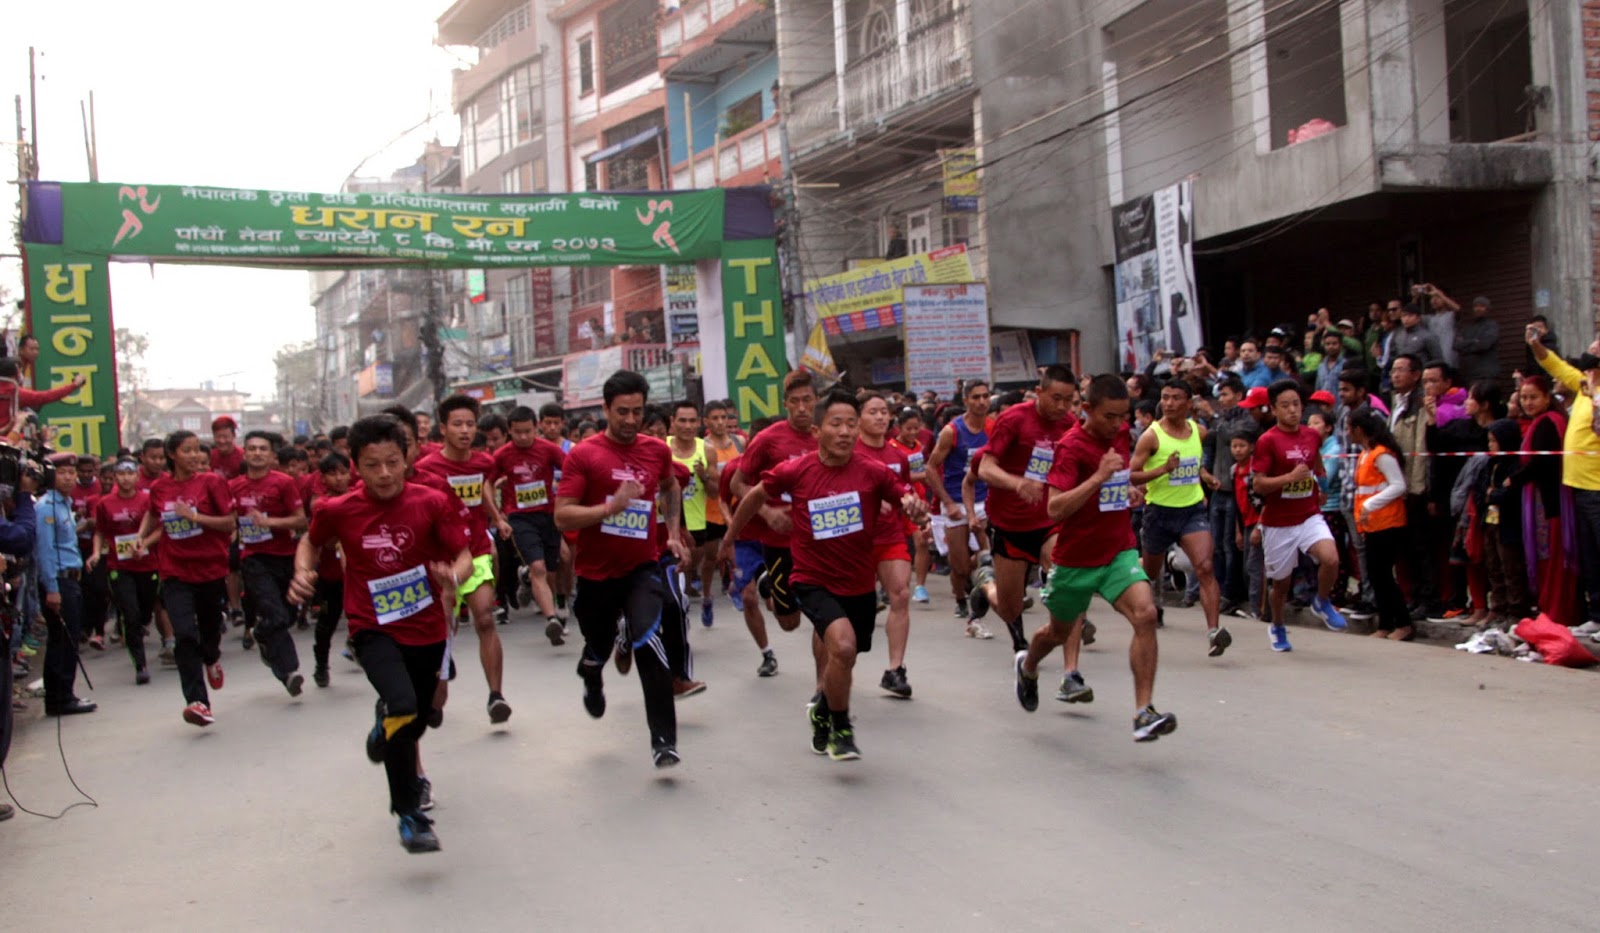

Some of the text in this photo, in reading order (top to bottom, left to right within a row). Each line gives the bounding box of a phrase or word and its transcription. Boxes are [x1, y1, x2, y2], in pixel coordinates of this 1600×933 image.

[289, 205, 531, 239] धरान रन
[552, 237, 618, 252] २०७३
[451, 484, 482, 500] 114
[517, 488, 546, 502] 2409
[811, 506, 861, 531] 3582
[832, 527, 850, 535] OPEN
[373, 580, 430, 614] 3241
[399, 604, 419, 616] OPEN
